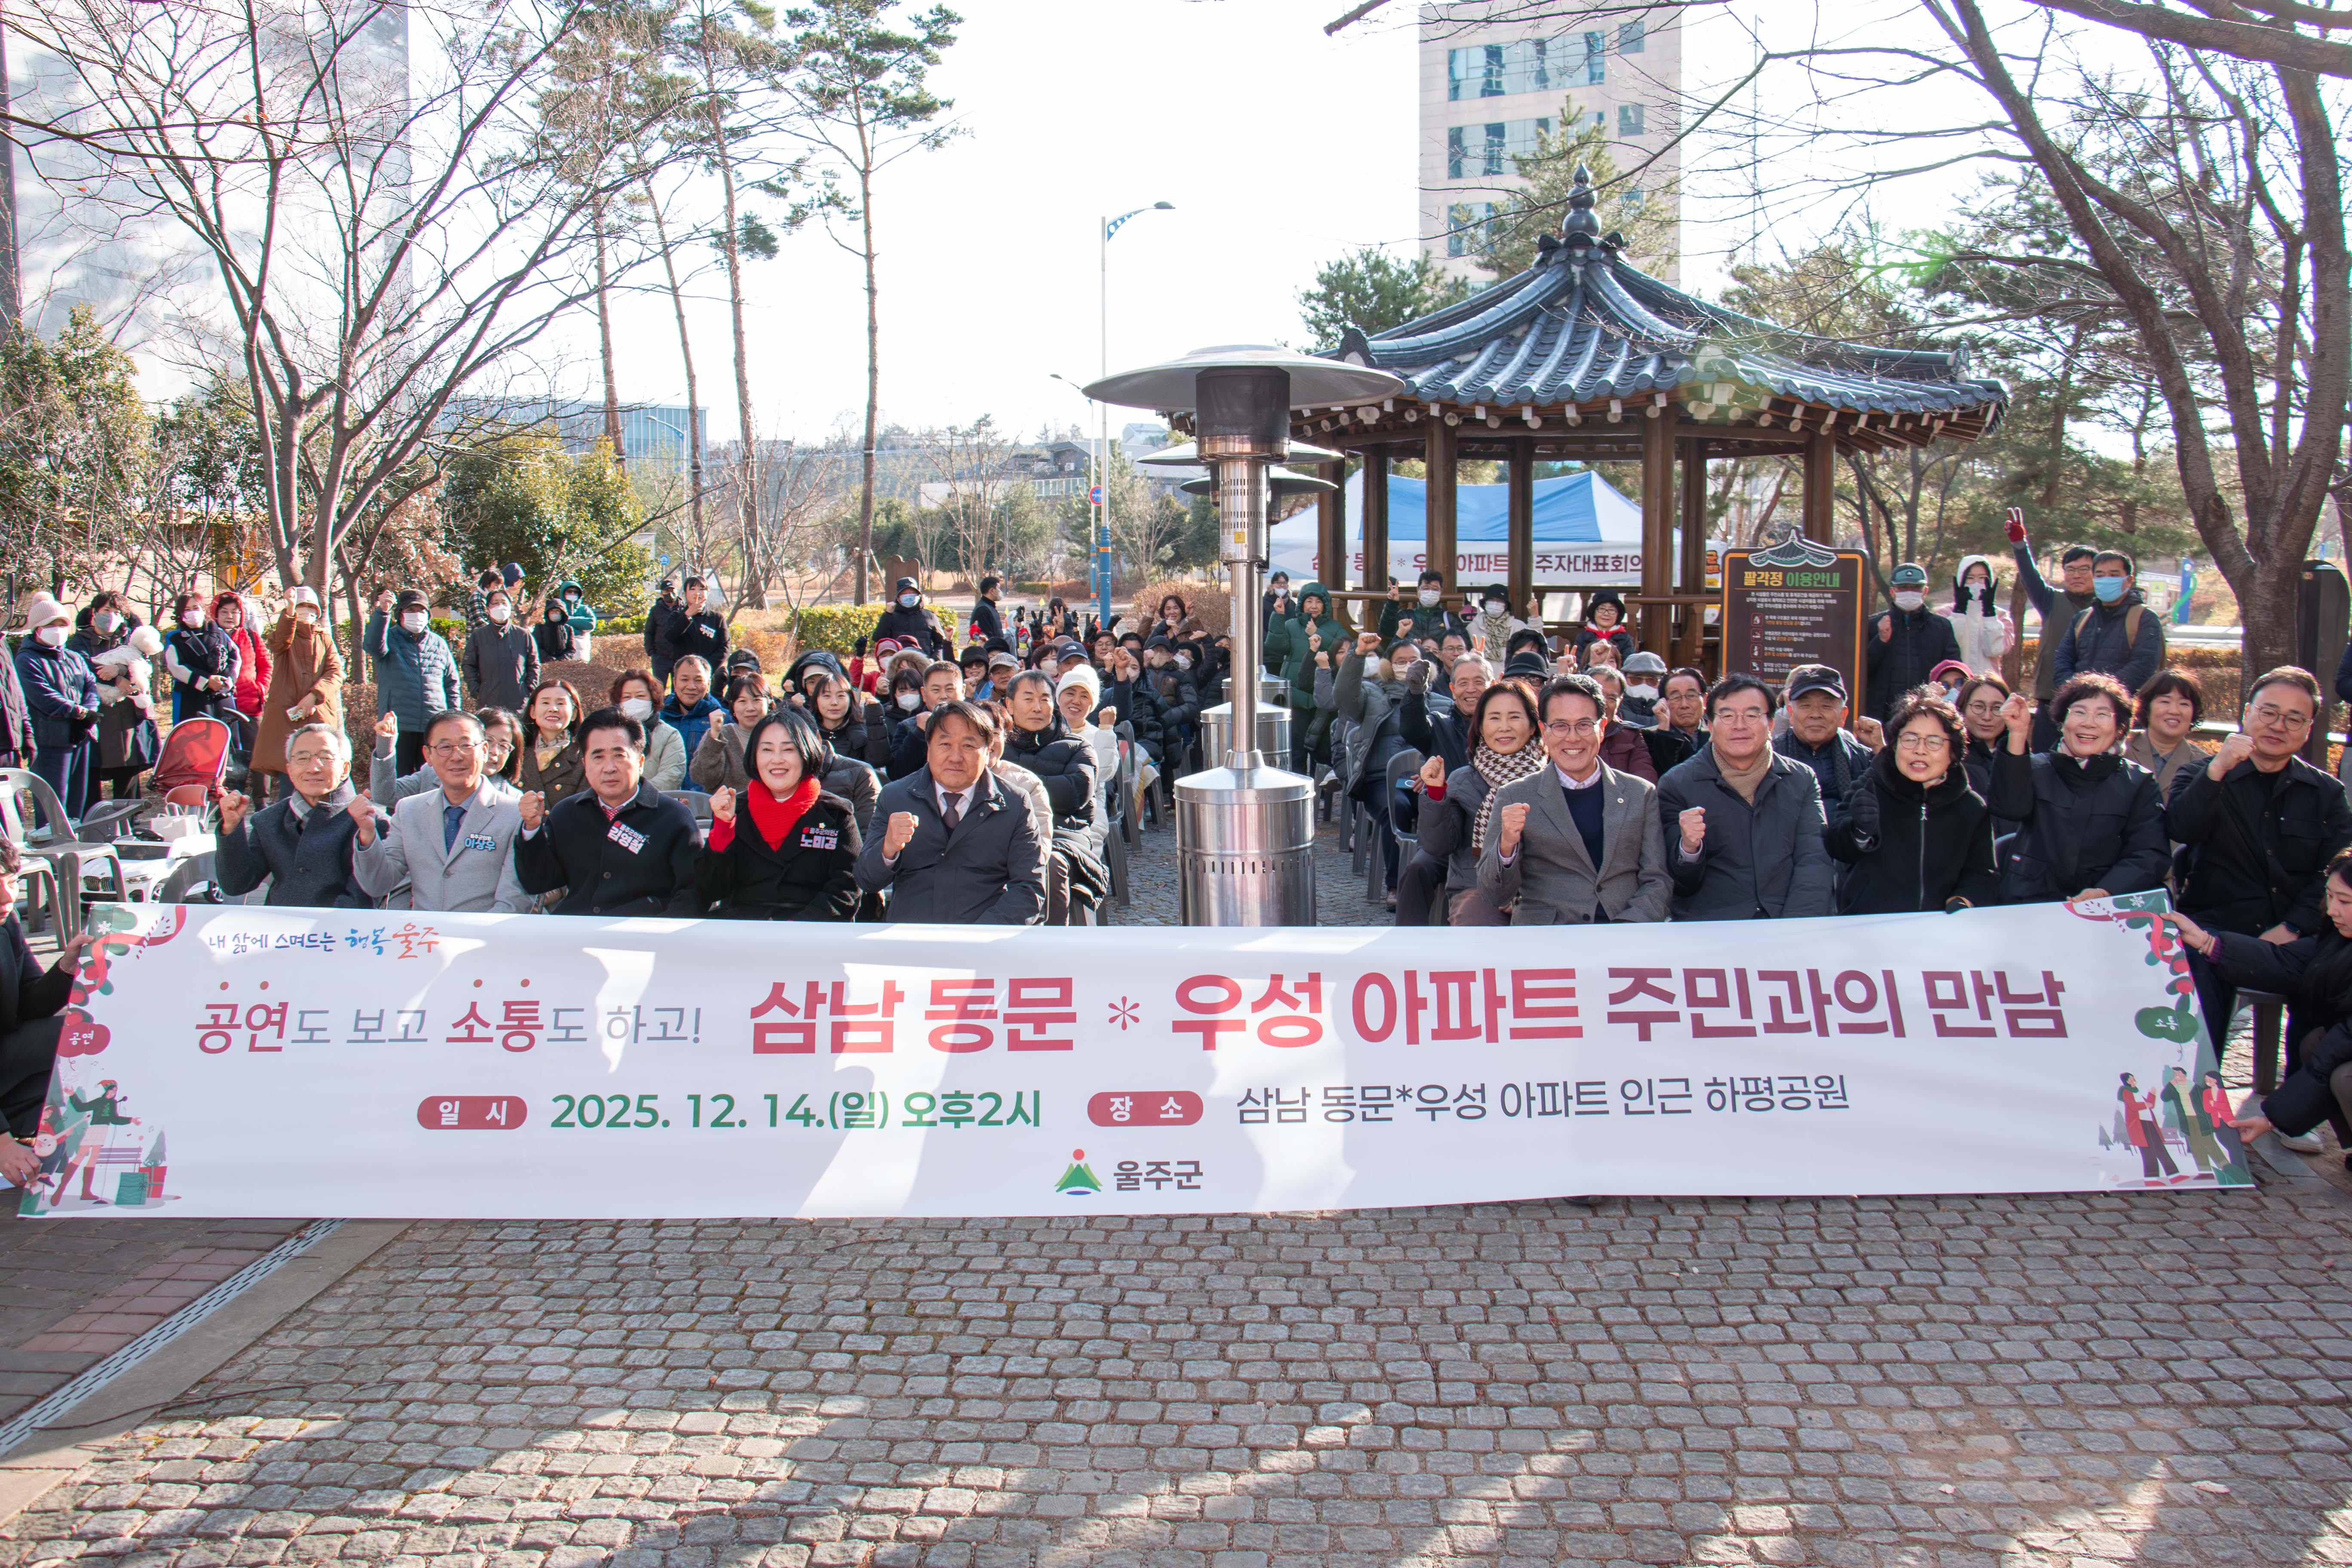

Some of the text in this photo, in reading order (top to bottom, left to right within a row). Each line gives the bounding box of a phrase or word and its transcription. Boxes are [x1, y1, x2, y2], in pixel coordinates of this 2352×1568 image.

[1456, 554, 1508, 572] 아파트
[1535, 554, 1642, 573] 주자대표회의
[1744, 571, 1840, 588] 팔각정 이용안내
[465, 837, 496, 851] 이상우
[607, 826, 643, 854] 김영철
[800, 834, 838, 850] 노미경
[209, 922, 440, 960] 내 삶에 스며드는 행복 울주
[195, 1001, 331, 1054] 공연도
[346, 1009, 428, 1044] 보고
[446, 1000, 588, 1053] 소통도
[606, 1004, 701, 1044] 하고!
[750, 980, 905, 1054] 삼남
[924, 977, 1077, 1054] 동문
[1172, 972, 1323, 1051] 우성
[1352, 968, 1583, 1045] 아파트
[1607, 967, 1906, 1042] 주민과의
[1921, 970, 2069, 1039] 만남
[2155, 1015, 2178, 1030] 소통
[69, 1030, 94, 1045] 공연
[551, 1094, 670, 1129] 2025.
[687, 1093, 747, 1128] 12.
[902, 1090, 1040, 1129] 오후2시
[1237, 1087, 1311, 1125] 삼남
[1500, 1081, 1610, 1119] 아파트
[1620, 1078, 1693, 1116] 인근
[1704, 1074, 1850, 1113] 하평공원
[1113, 1160, 1204, 1192] 울주군
